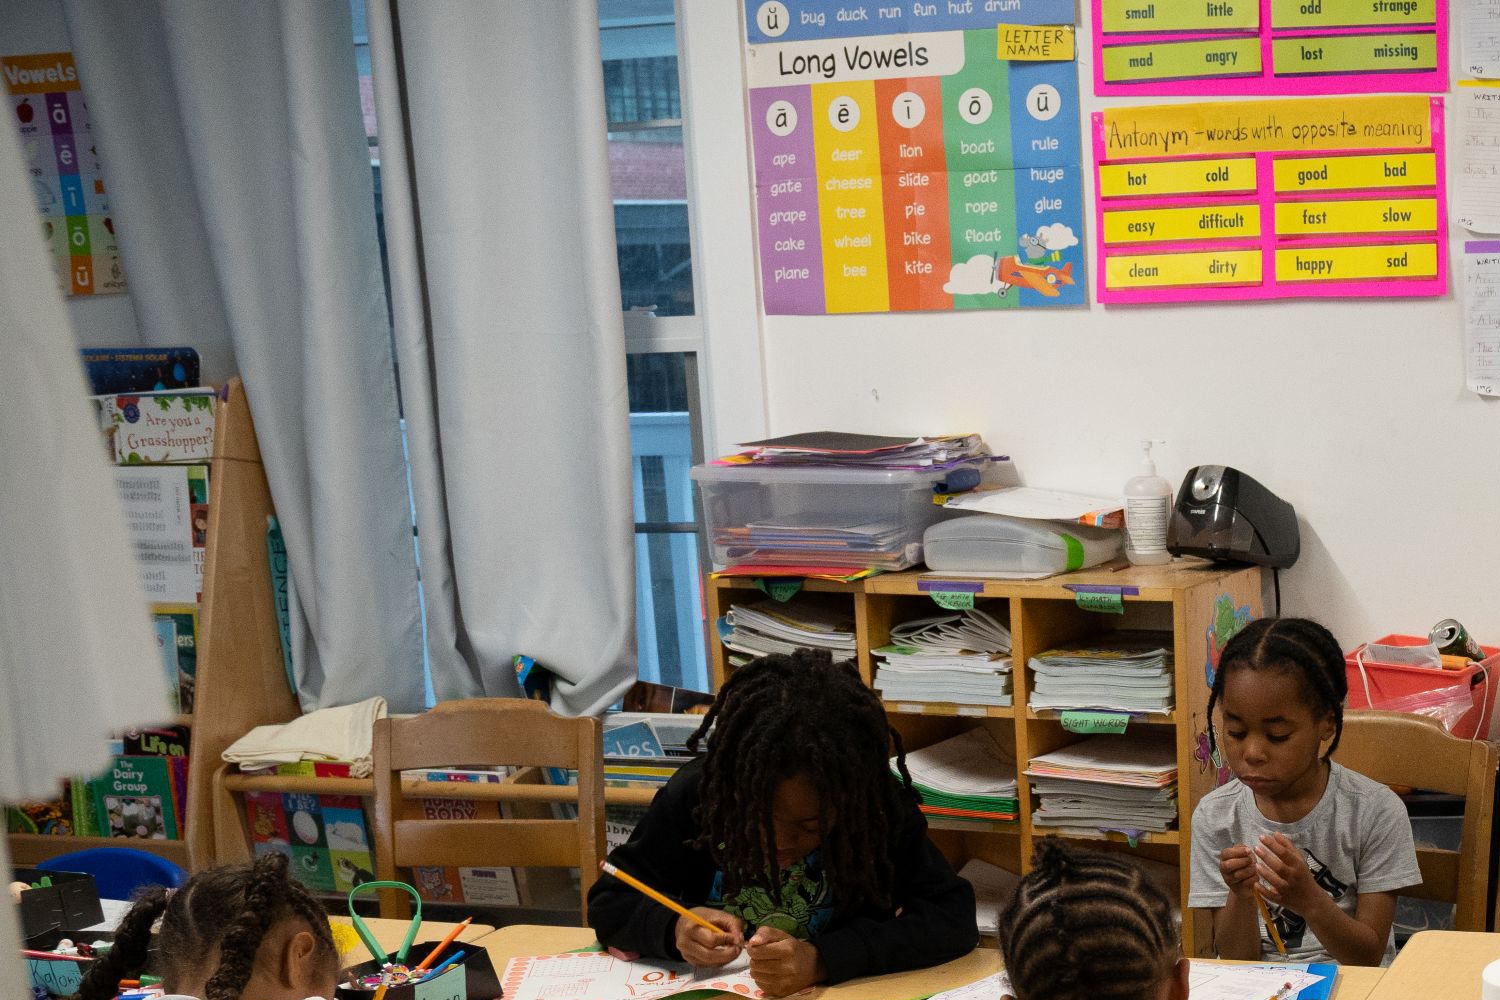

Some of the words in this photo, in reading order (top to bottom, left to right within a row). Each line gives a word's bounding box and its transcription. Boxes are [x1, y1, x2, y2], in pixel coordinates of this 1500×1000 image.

[801, 10, 826, 26] bug
[836, 8, 869, 21] duck
[879, 7, 901, 19] run
[913, 4, 937, 16] fun
[948, 0, 973, 14] hut
[984, 0, 1021, 12] drum
[1125, 5, 1155, 20] small
[1206, 3, 1234, 17] little
[1300, 0, 1322, 14] odd
[1372, 0, 1418, 15] strange
[1005, 30, 1064, 45] LETTER
[1006, 45, 1050, 56] NAME
[1301, 47, 1323, 61] lost
[1374, 45, 1418, 61] missing
[779, 51, 836, 78] Long
[844, 42, 929, 71] Vowels
[1129, 54, 1153, 68] mad
[1205, 50, 1238, 65] angry
[4, 62, 76, 85] Vowels
[1109, 121, 1187, 152] Antonym
[1252, 116, 1284, 140] with
[1292, 112, 1357, 140] opposite
[1364, 122, 1424, 145] meaning
[900, 144, 923, 157] lion
[960, 140, 995, 154] boat
[1032, 137, 1059, 150] rule
[773, 153, 796, 166] ape
[831, 148, 862, 162] deer
[898, 173, 929, 187] slide
[963, 170, 998, 186] goat
[1030, 168, 1064, 183] huge
[1128, 172, 1147, 185] hot
[1205, 167, 1229, 182] cold
[1298, 167, 1328, 184] good
[1384, 162, 1407, 178] bad
[770, 181, 802, 196] gate
[825, 176, 873, 191] cheese
[836, 205, 866, 219] tree
[905, 202, 925, 218] pie
[965, 201, 998, 215] rope
[1035, 198, 1062, 213] glue
[769, 209, 807, 225] grape
[1302, 210, 1327, 224] fast
[1382, 208, 1412, 222] slow
[1128, 220, 1155, 235] easy
[1198, 214, 1244, 229] difficult
[834, 235, 872, 248] wheel
[903, 232, 931, 246] bike
[965, 229, 1001, 243] float
[775, 238, 805, 252] cake
[843, 264, 867, 277] bee
[905, 261, 932, 274] kite
[1128, 263, 1159, 277] clean
[1209, 260, 1237, 277] dirty
[1296, 258, 1333, 274] happy
[1386, 252, 1408, 268] sad
[775, 267, 810, 281] plane
[146, 413, 167, 426] Are
[167, 418, 192, 432] you
[128, 428, 213, 453] Grasshopper?
[1063, 718, 1090, 729] SIGHT
[1093, 718, 1127, 729] WORDS
[141, 734, 167, 755] Life
[169, 743, 185, 755] on
[113, 769, 144, 782] Dairy
[113, 782, 148, 792] Group
[425, 807, 478, 819] BODY
